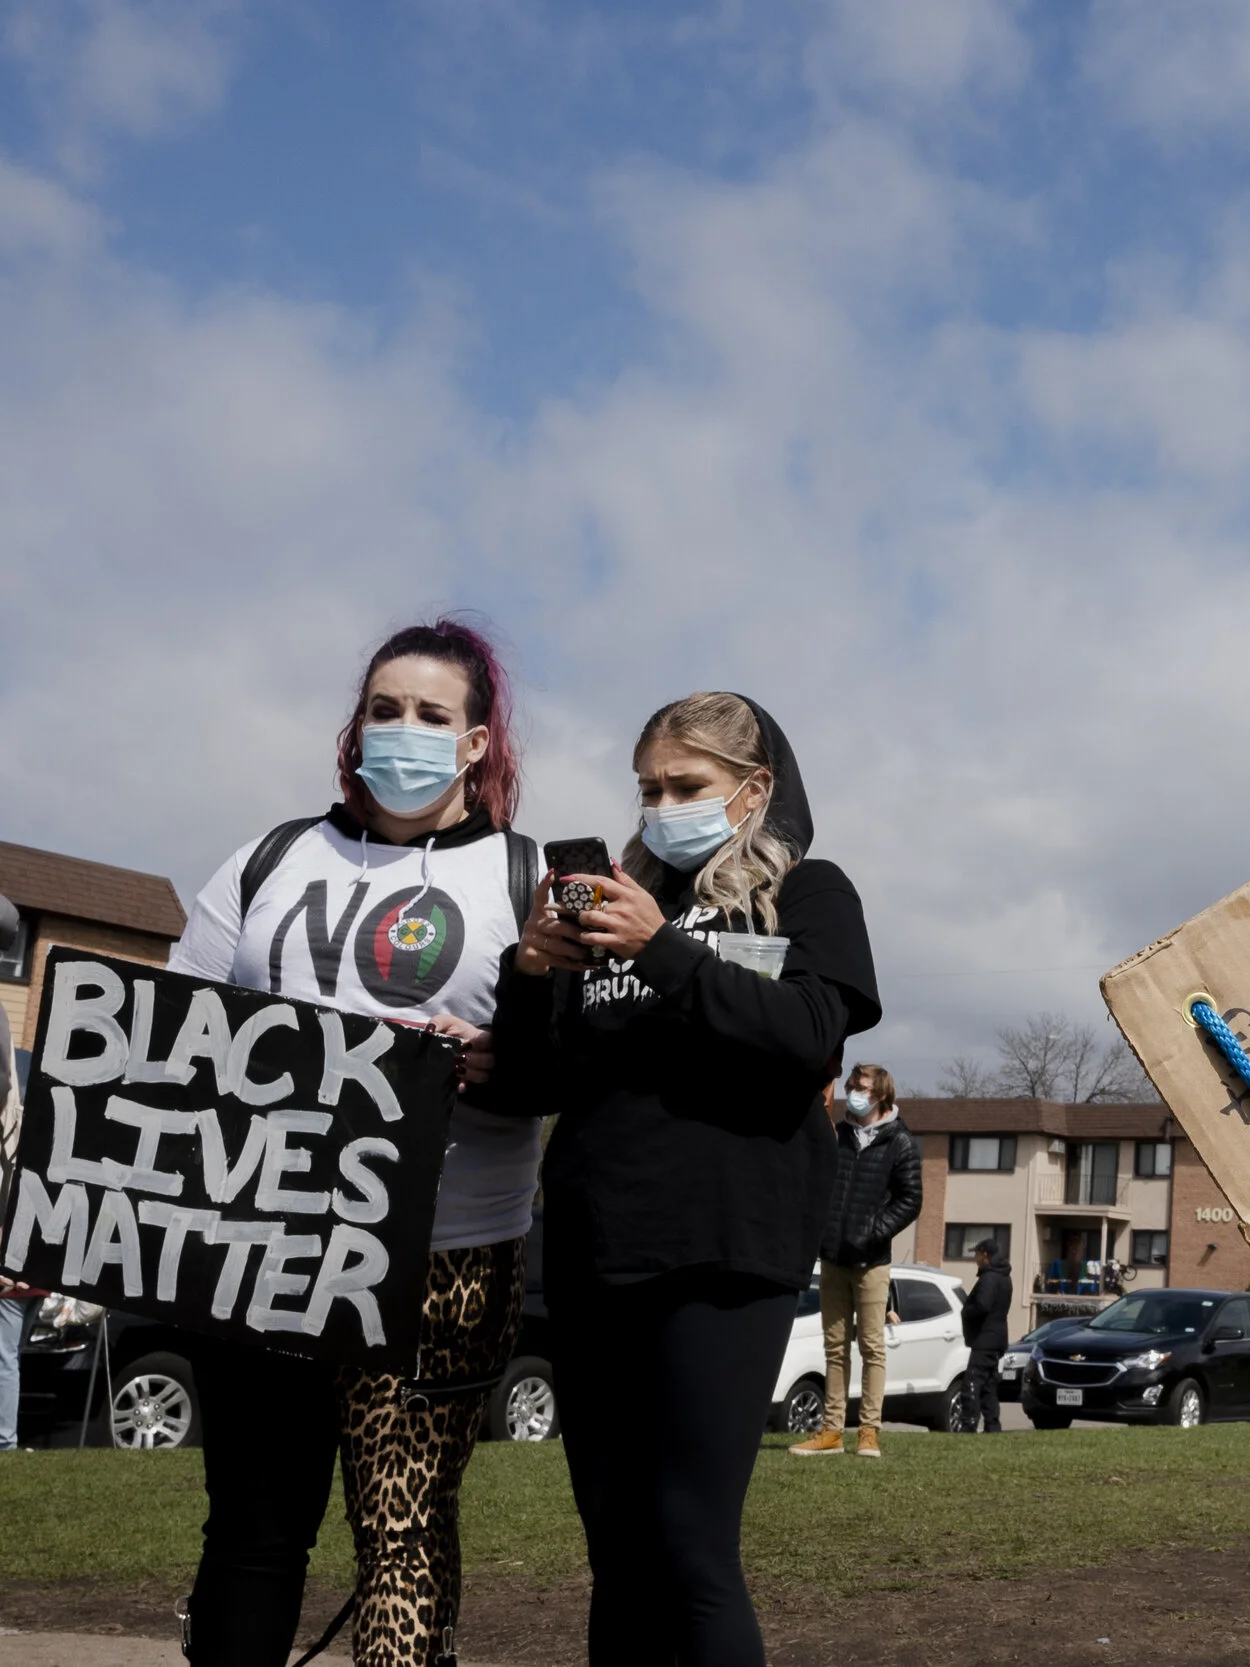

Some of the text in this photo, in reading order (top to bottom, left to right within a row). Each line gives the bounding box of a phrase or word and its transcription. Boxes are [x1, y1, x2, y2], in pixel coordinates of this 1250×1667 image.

[269, 880, 465, 1008] NO
[390, 935, 431, 950] COLOURS
[41, 961, 404, 1122] BLACK
[47, 1086, 400, 1224] LIVES
[1195, 1206, 1233, 1222] 1400
[4, 1166, 390, 1348] MATTER
